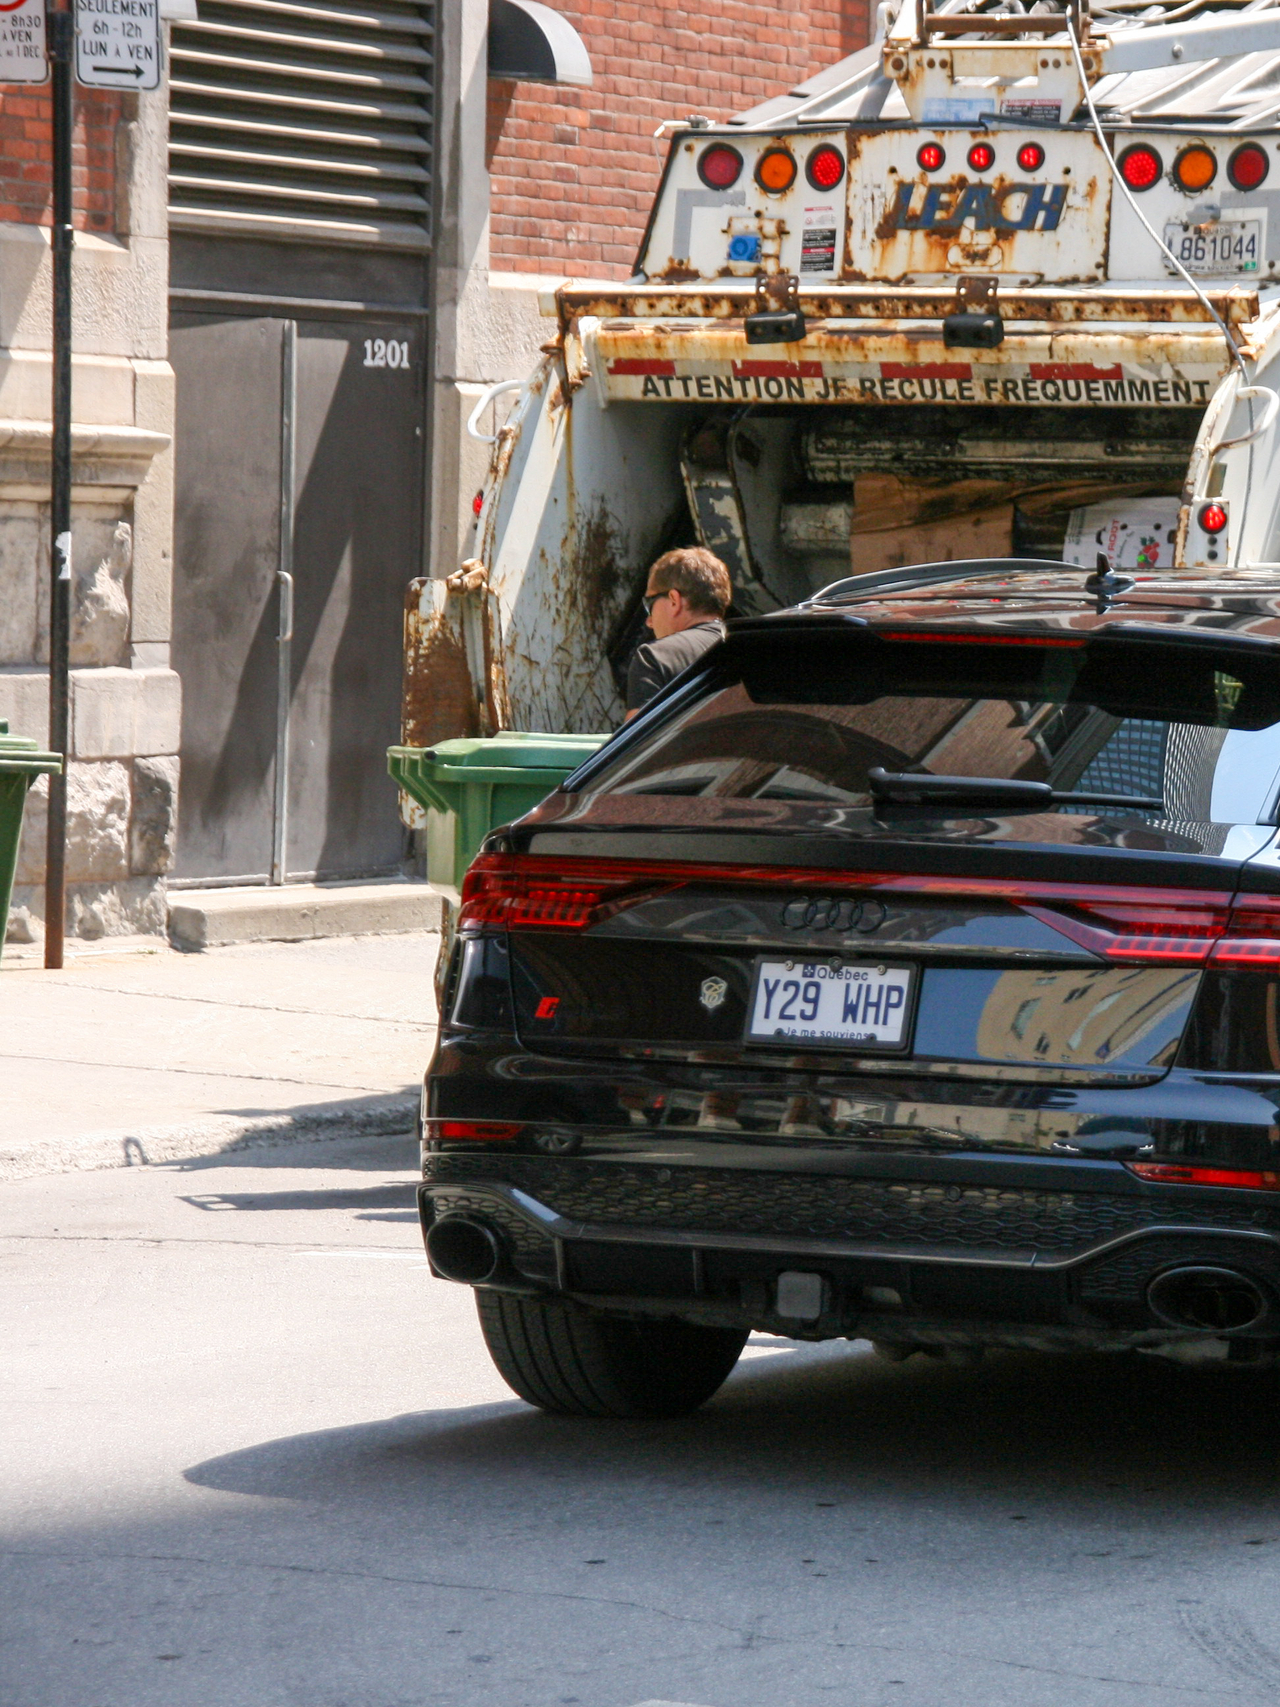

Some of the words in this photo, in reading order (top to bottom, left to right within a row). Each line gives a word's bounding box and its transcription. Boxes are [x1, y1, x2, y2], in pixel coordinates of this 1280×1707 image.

[79, 0, 155, 18] SEULEMENT
[11, 15, 41, 28] 8h30
[93, 20, 109, 35] 6h
[122, 22, 142, 38] 12h
[10, 30, 32, 42] VEN
[23, 45, 40, 58] DEC
[82, 40, 107, 56] LUN
[128, 44, 152, 60] VEN
[890, 183, 1069, 230] LEACH
[363, 338, 410, 369] 1201
[642, 375, 805, 399] ATTENTION
[859, 378, 975, 401] RECULE
[763, 978, 821, 1021] Y29
[842, 983, 905, 1026] WHP
[801, 1029, 816, 1037] me
